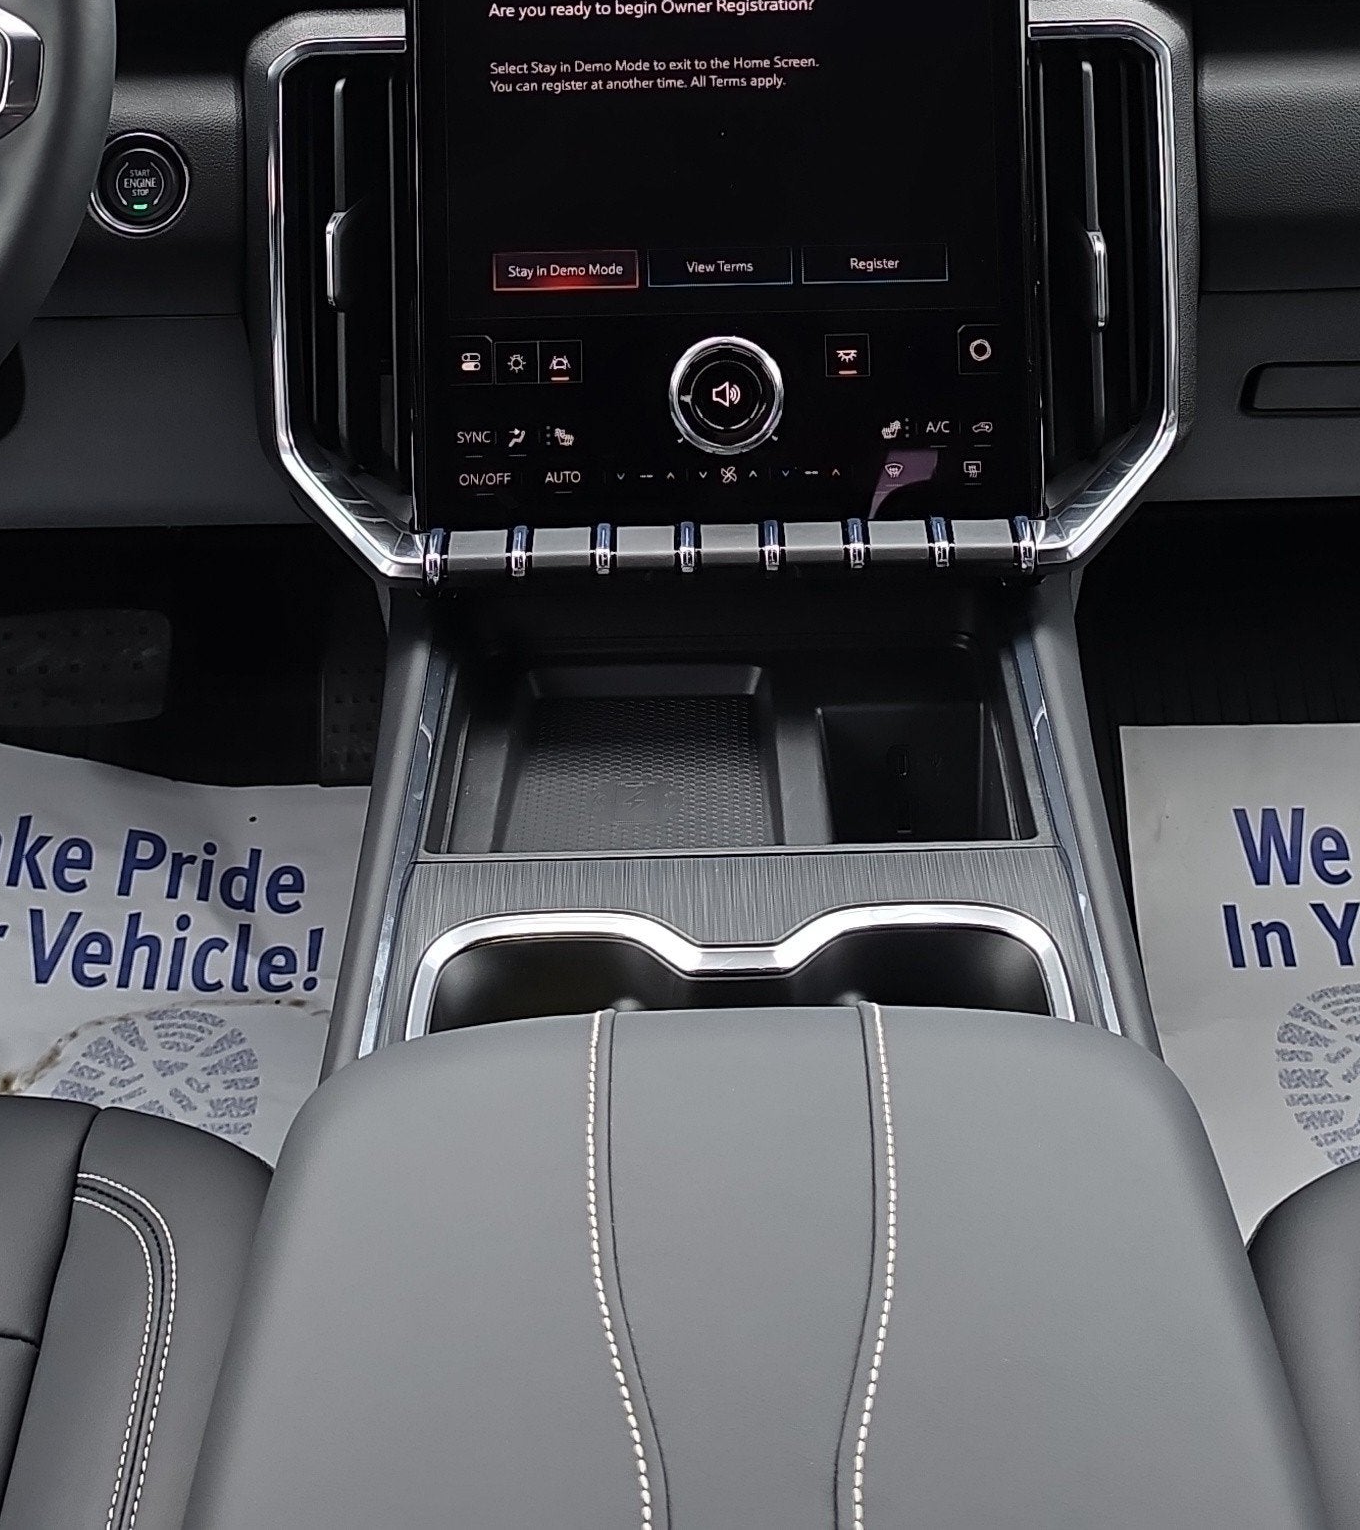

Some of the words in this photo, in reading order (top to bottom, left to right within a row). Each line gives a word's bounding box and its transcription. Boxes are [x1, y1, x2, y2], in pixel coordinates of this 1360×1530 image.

[489, 3, 515, 17] Are
[518, 6, 546, 21] you
[550, 1, 592, 20] ready
[595, 3, 612, 16] to
[615, 0, 658, 19] begin
[661, 0, 713, 15] Owner
[490, 62, 528, 75] Select
[531, 62, 557, 77] Stay
[560, 62, 571, 73] in
[574, 60, 612, 72] Demo
[615, 59, 651, 72] Mode
[653, 60, 666, 71] to
[669, 58, 692, 70] exit
[694, 59, 707, 70] to
[709, 57, 731, 69] the
[733, 57, 771, 69] Home
[774, 56, 820, 68] Screen.
[490, 80, 514, 93] You
[516, 82, 538, 92] can
[541, 79, 588, 94] register
[590, 79, 604, 90] at
[605, 77, 654, 90] another
[657, 77, 688, 88] time.
[690, 75, 707, 88] All
[709, 75, 747, 88] Terms
[750, 74, 787, 90] apply.
[129, 169, 150, 177] START
[124, 177, 157, 188] ENGINE
[508, 265, 534, 279] Stay
[536, 265, 548, 277] in
[550, 264, 585, 276] Demo
[588, 263, 624, 276] Mode
[686, 261, 715, 273] View
[718, 261, 754, 273] Terms
[850, 257, 900, 273] Register
[926, 420, 950, 435] A/C
[456, 430, 492, 445] SYNC
[458, 470, 512, 487] ON/OFF
[544, 469, 581, 484] AUTO
[1231, 806, 1352, 887] We
[116, 828, 307, 916] Pride
[1221, 903, 1297, 970] In
[26, 907, 326, 993] Vehicle!
